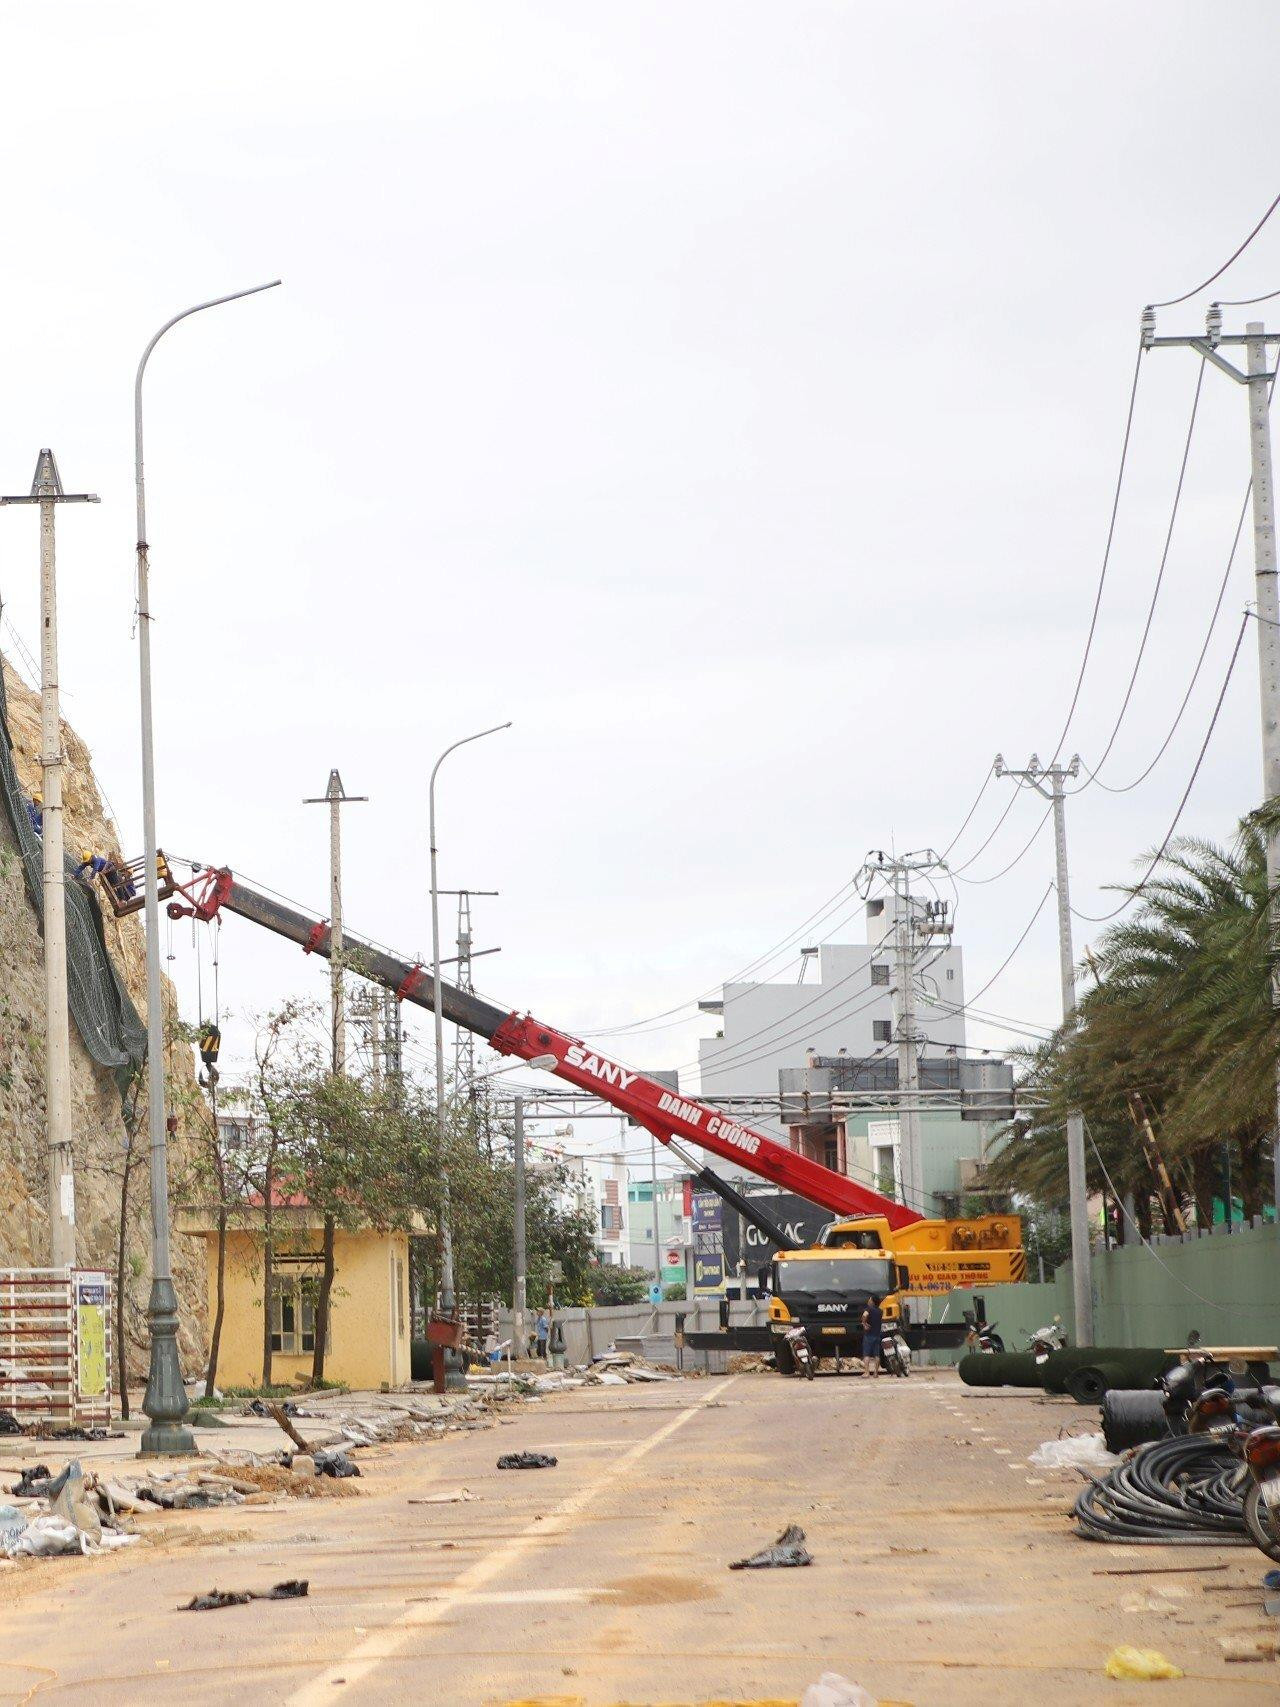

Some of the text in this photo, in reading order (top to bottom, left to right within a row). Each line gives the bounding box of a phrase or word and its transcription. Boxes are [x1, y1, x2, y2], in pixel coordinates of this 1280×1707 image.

[564, 1045, 638, 1090] SANY
[657, 1092, 703, 1126] DANH
[817, 1303, 848, 1313] SANY
